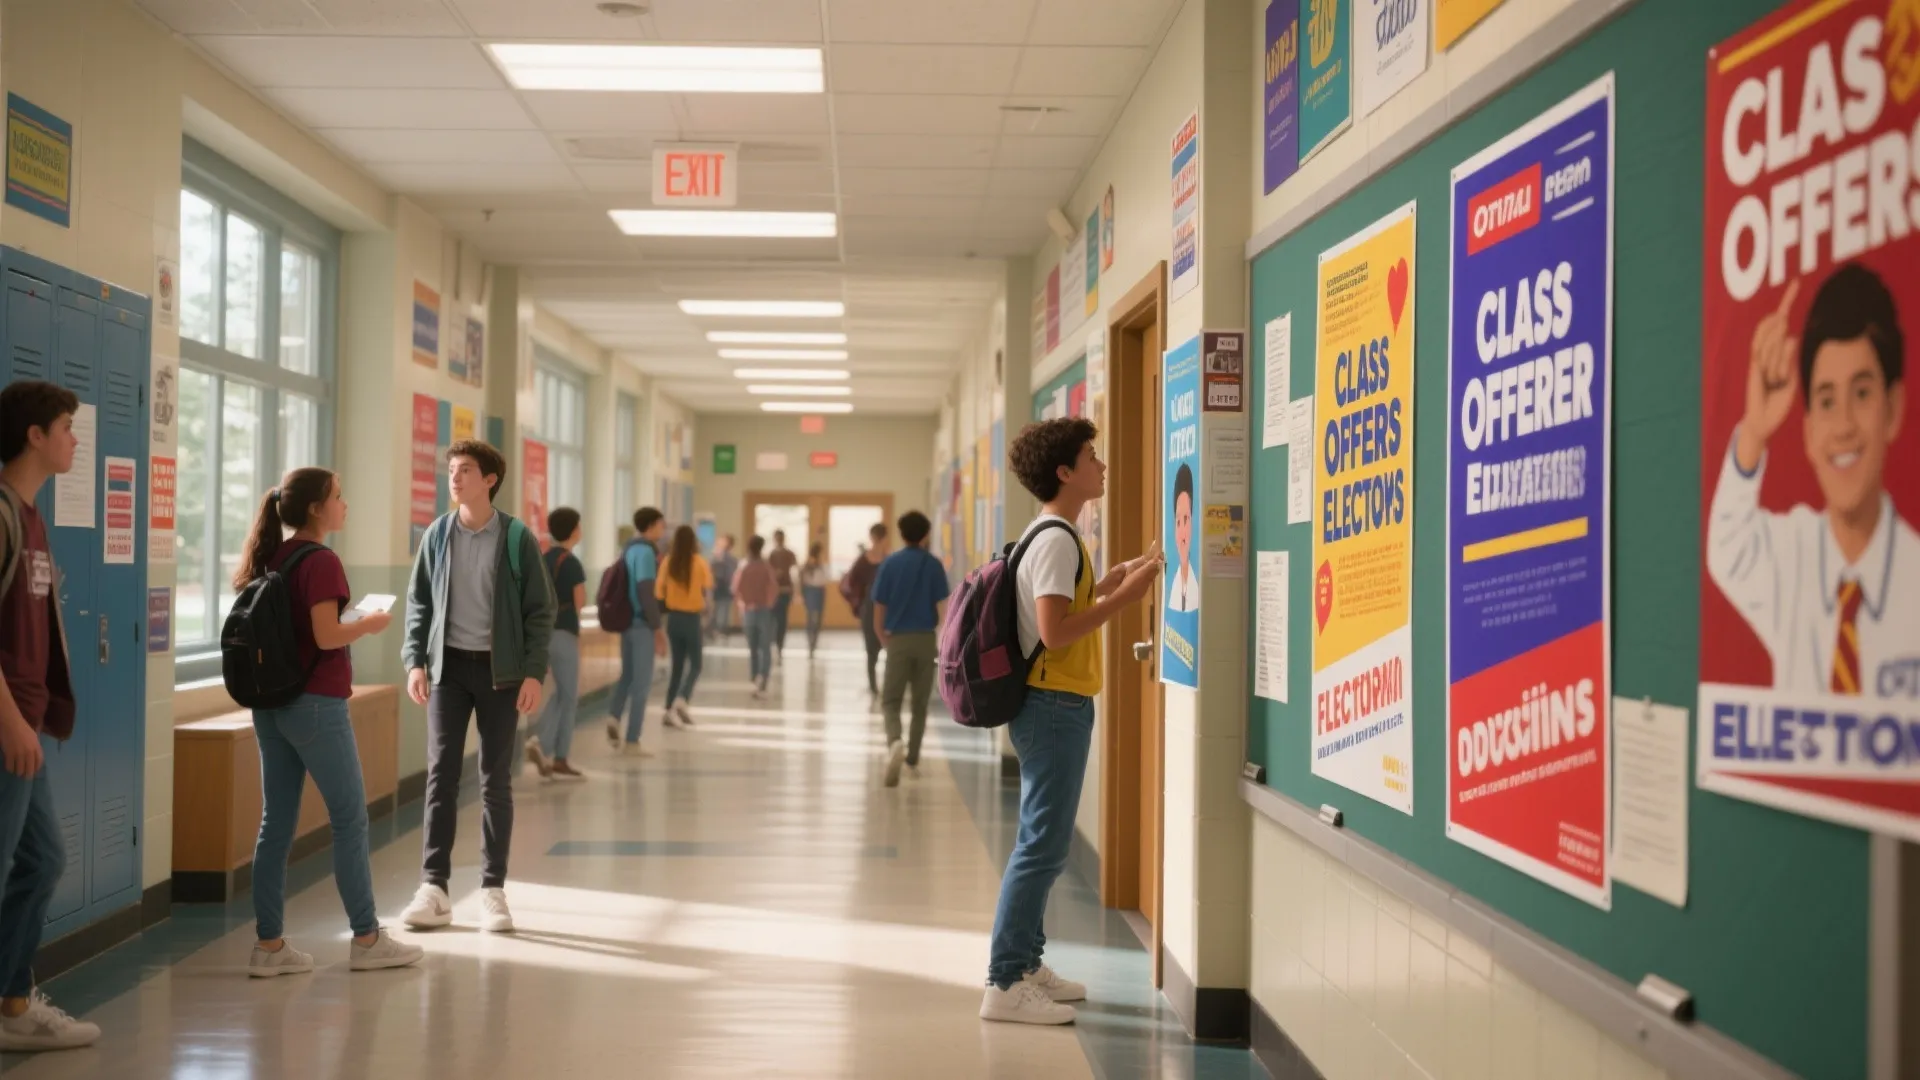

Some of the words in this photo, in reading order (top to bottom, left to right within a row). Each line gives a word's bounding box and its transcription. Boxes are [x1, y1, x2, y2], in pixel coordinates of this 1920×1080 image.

[1721, 15, 1886, 187] CLAS
[665, 153, 725, 197] EXIT
[1721, 116, 1920, 302] OFFER
[1476, 261, 1573, 364] CLASS
[1334, 335, 1389, 408] CLASS
[1461, 342, 1595, 451] OFFERER
[1323, 396, 1402, 477] OFFERS
